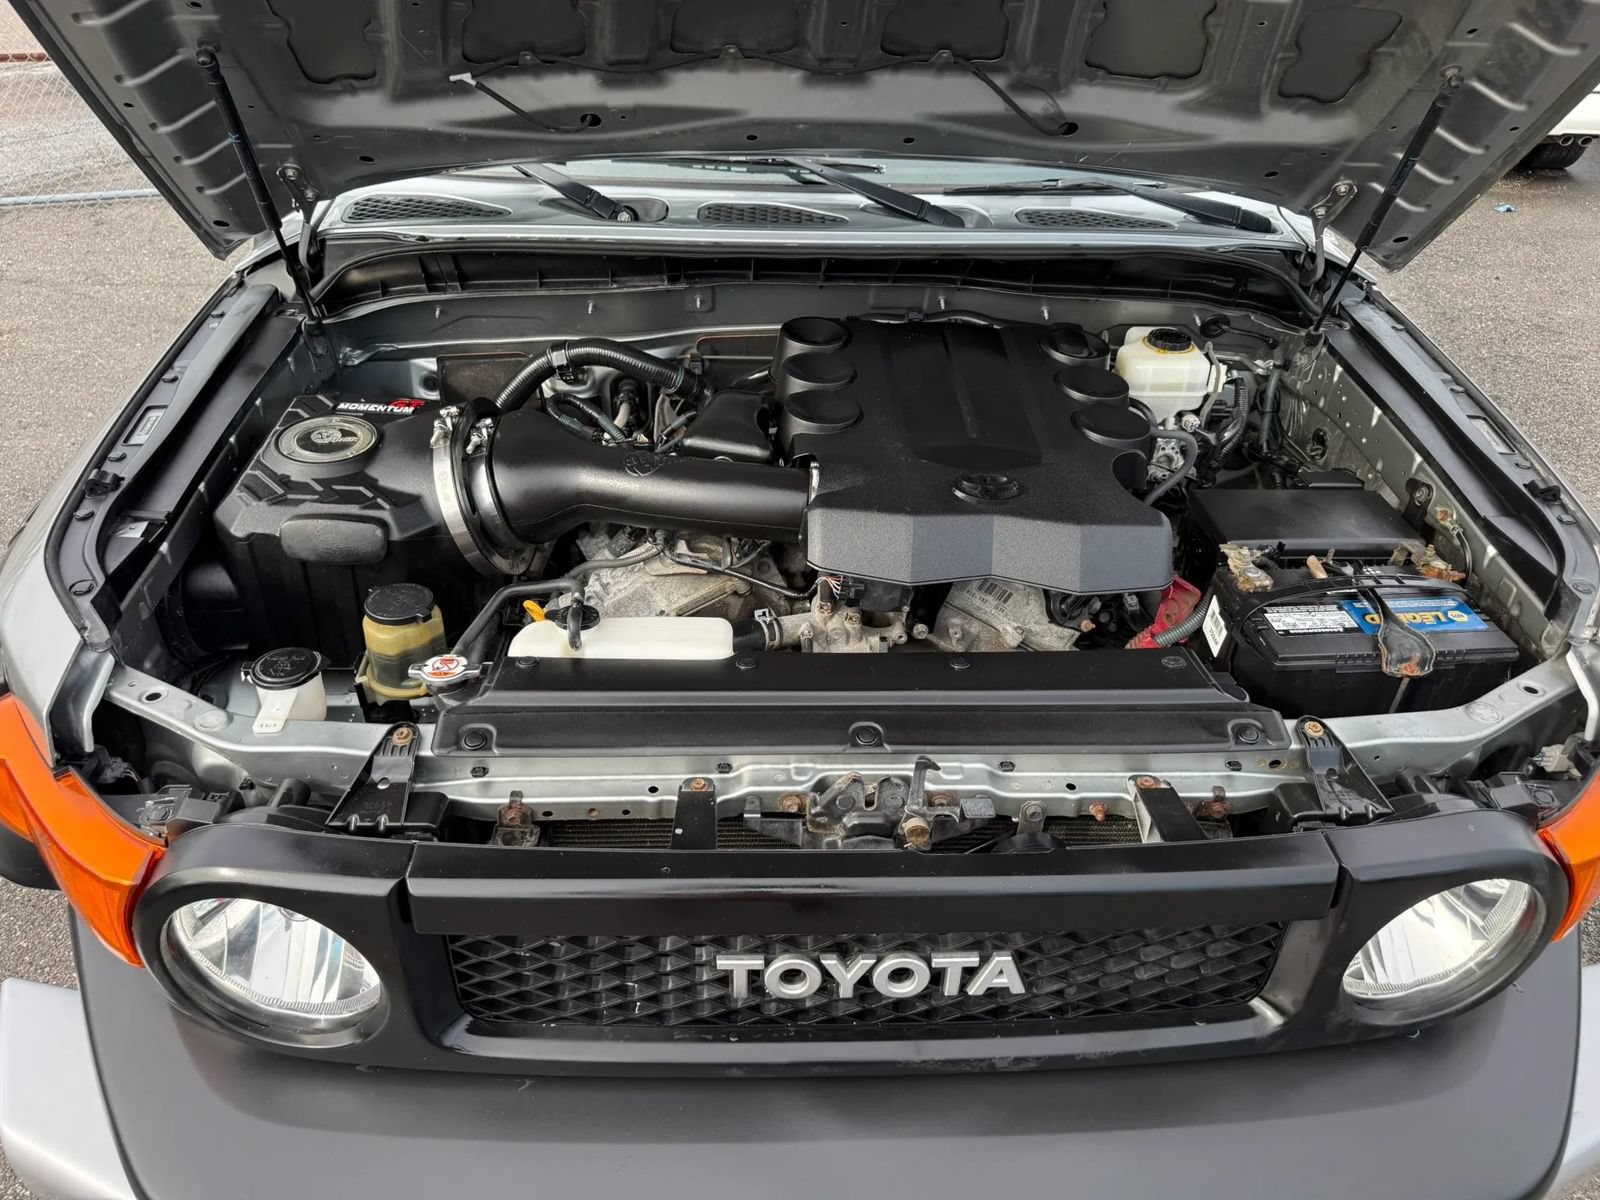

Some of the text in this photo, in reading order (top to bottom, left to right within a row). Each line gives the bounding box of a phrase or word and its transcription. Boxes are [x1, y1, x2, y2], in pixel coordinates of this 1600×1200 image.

[337, 399, 425, 414] MOMENTUM GT
[716, 952, 1026, 999] TOYOTA
